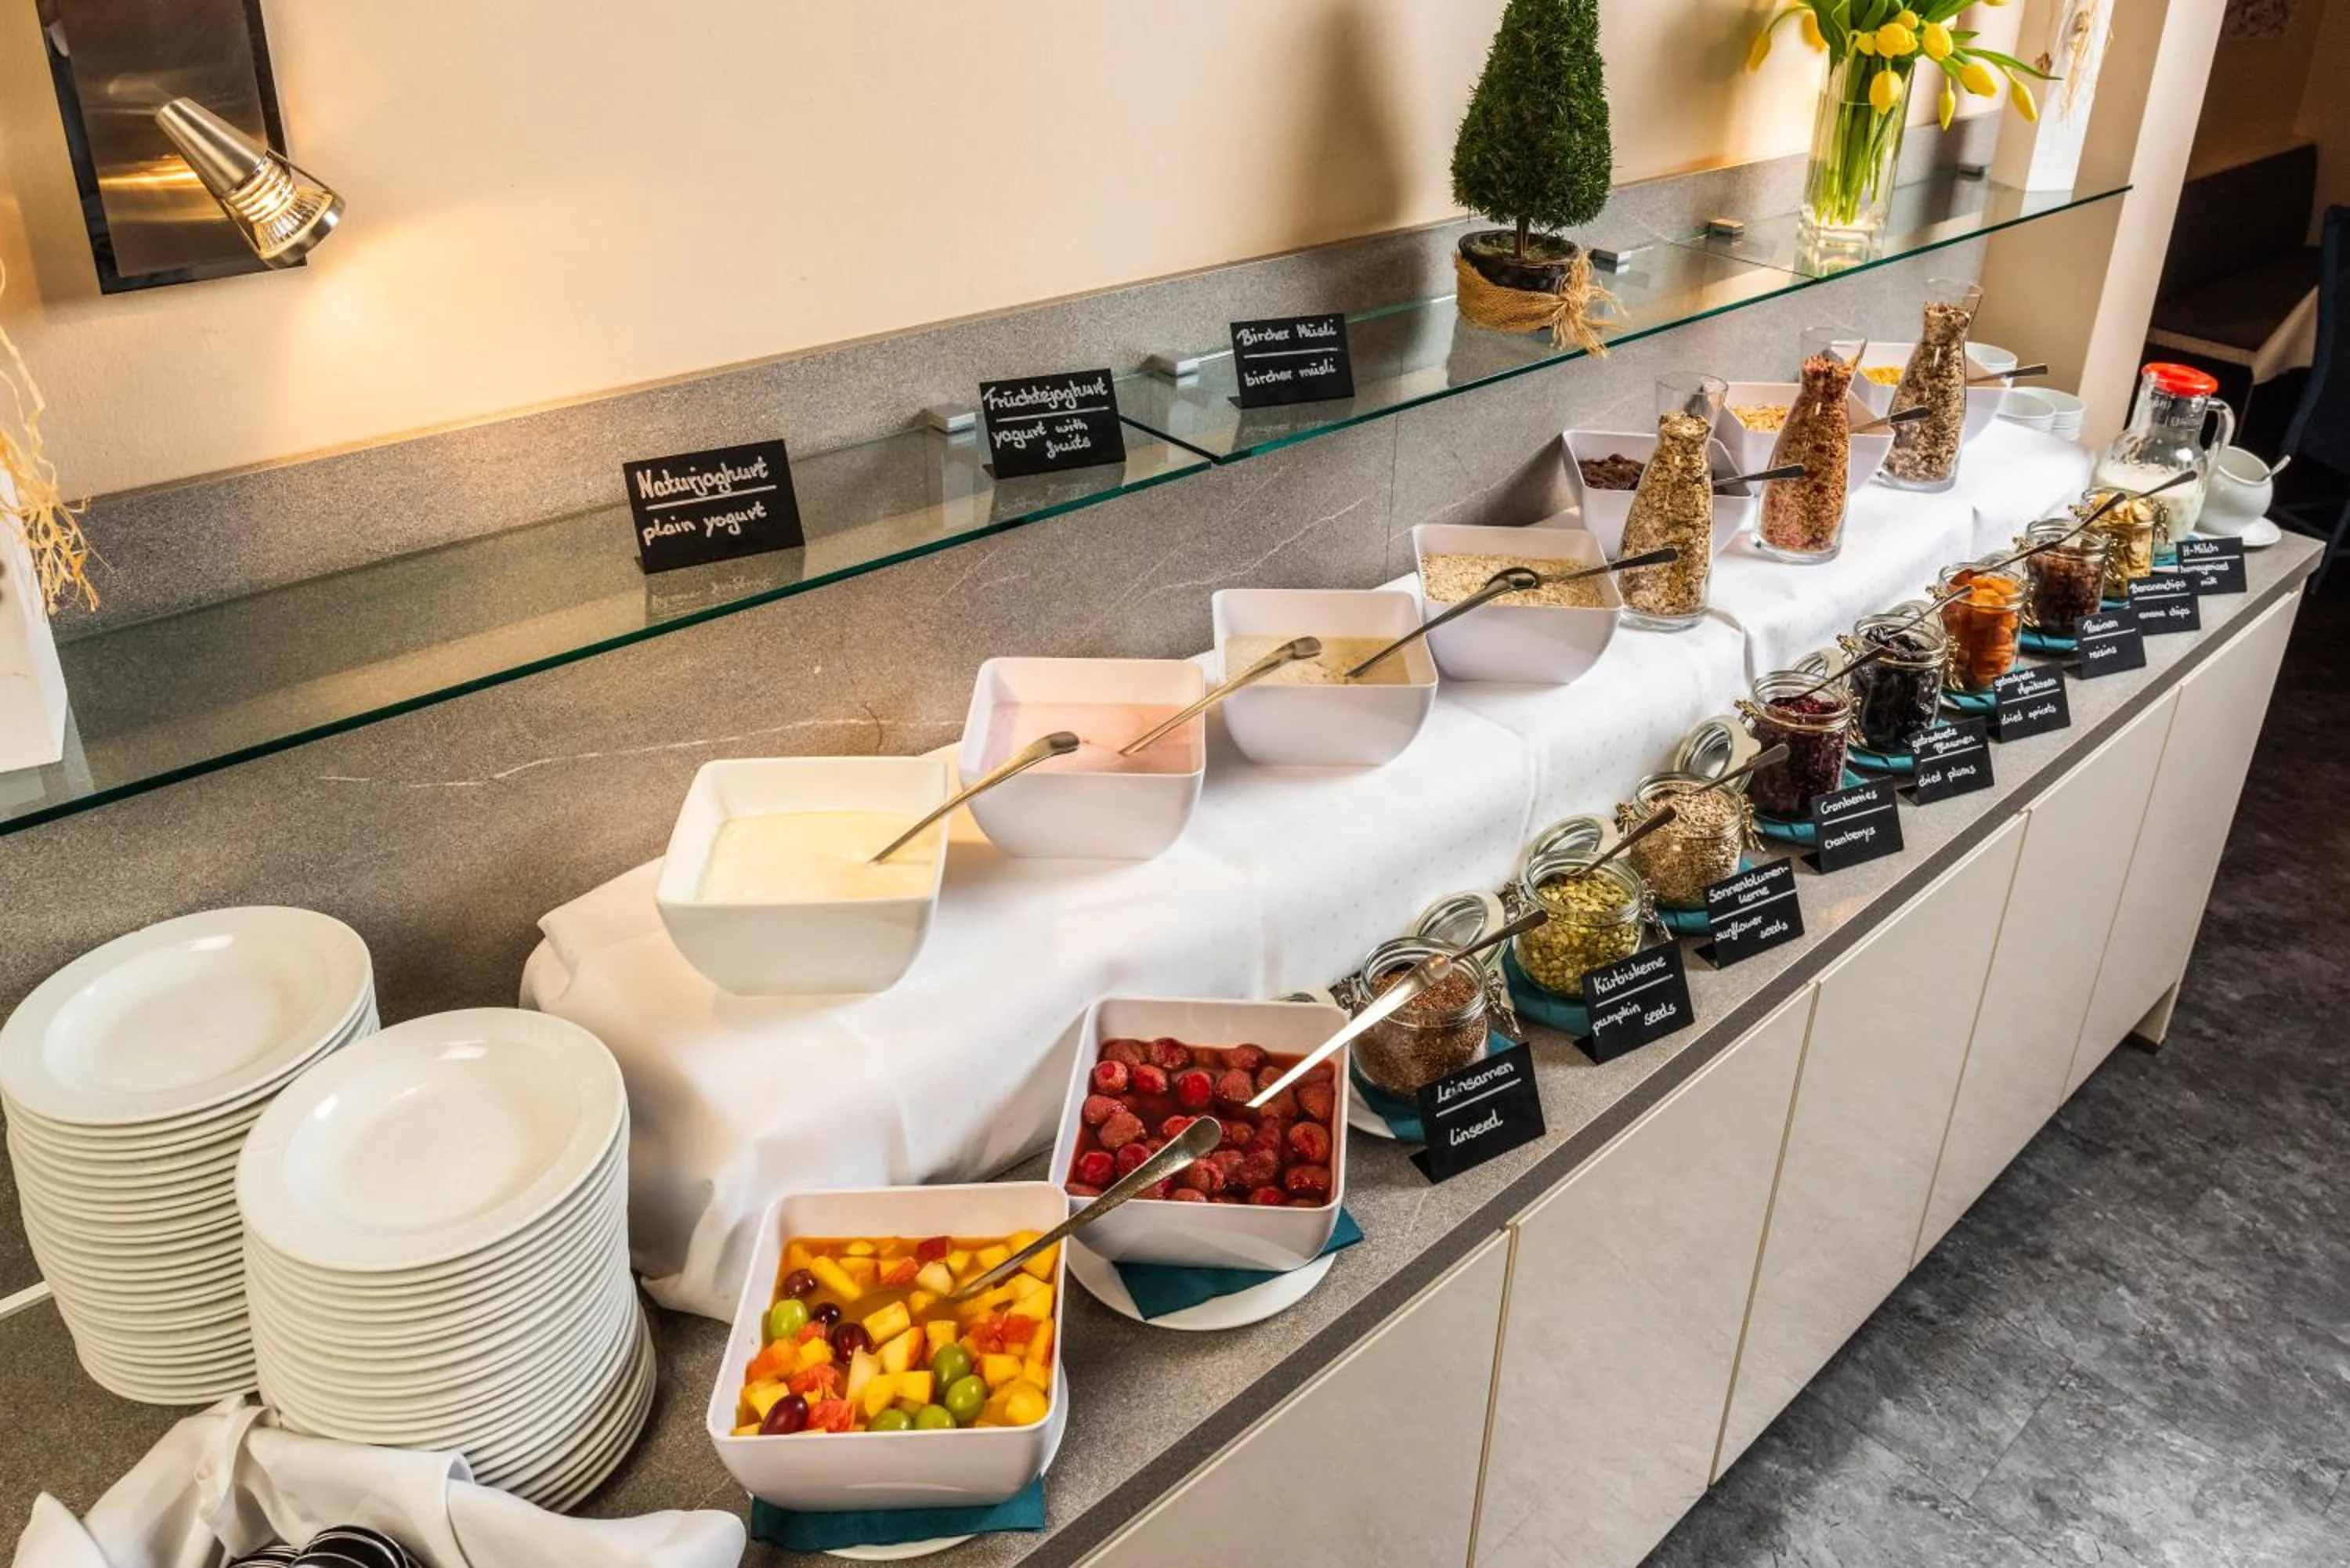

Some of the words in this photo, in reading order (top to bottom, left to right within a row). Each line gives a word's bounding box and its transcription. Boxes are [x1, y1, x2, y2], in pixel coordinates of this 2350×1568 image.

[1236, 327, 1290, 346] Bircher
[991, 420, 1047, 450] yogurt
[1055, 417, 1089, 434] with
[1046, 433, 1091, 460] fruits
[635, 455, 769, 499] Naturjoghurt
[642, 515, 696, 547] plain
[703, 500, 768, 538] yogurt
[2001, 709, 2023, 726] dried
[1918, 770, 1943, 787] dried
[1820, 789, 1878, 815] Cranberries
[1714, 915, 1763, 942] sunflower
[1591, 1001, 1642, 1038] pumpkin
[1643, 1002, 1677, 1026] seeds
[1436, 1061, 1515, 1104] Leinsamen
